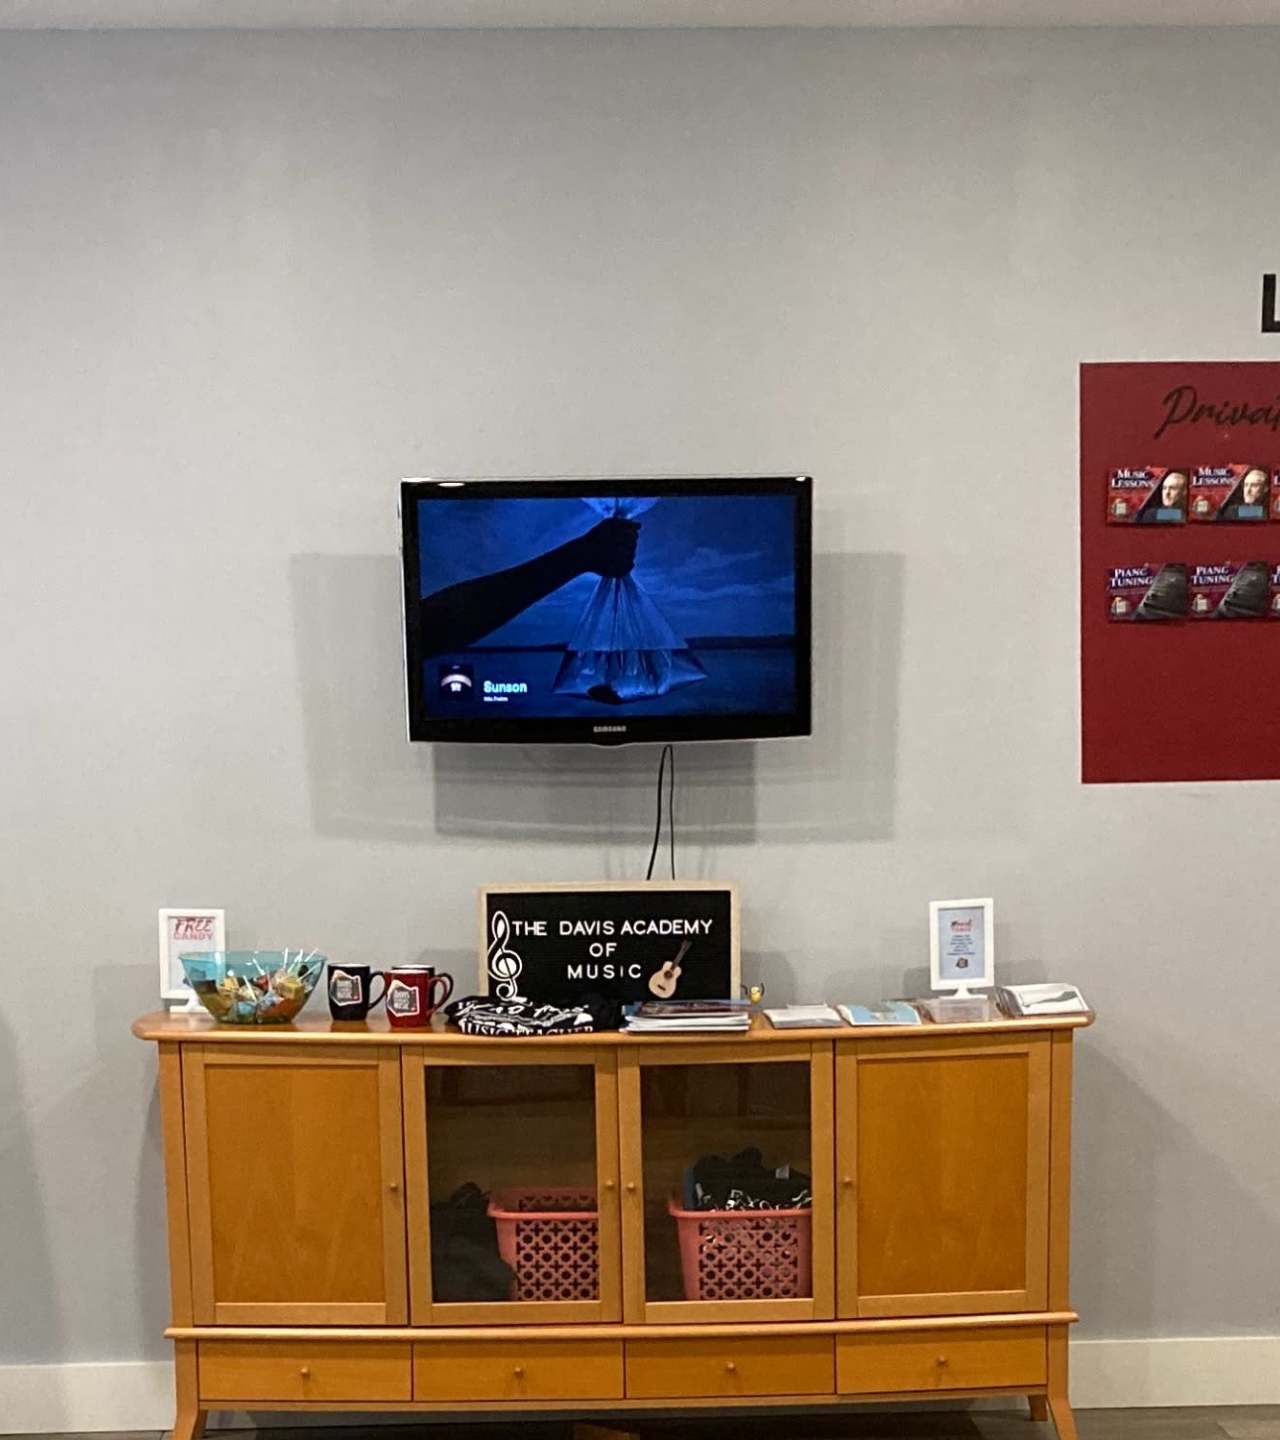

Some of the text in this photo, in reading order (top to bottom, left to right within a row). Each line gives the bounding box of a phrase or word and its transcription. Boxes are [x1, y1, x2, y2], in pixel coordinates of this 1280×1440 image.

[483, 680, 528, 694] Sunson
[175, 918, 213, 933] FREE
[512, 919, 713, 936] THE DAVIS ACADEMY
[589, 942, 617, 958] OF
[567, 964, 642, 979] MUSIC
